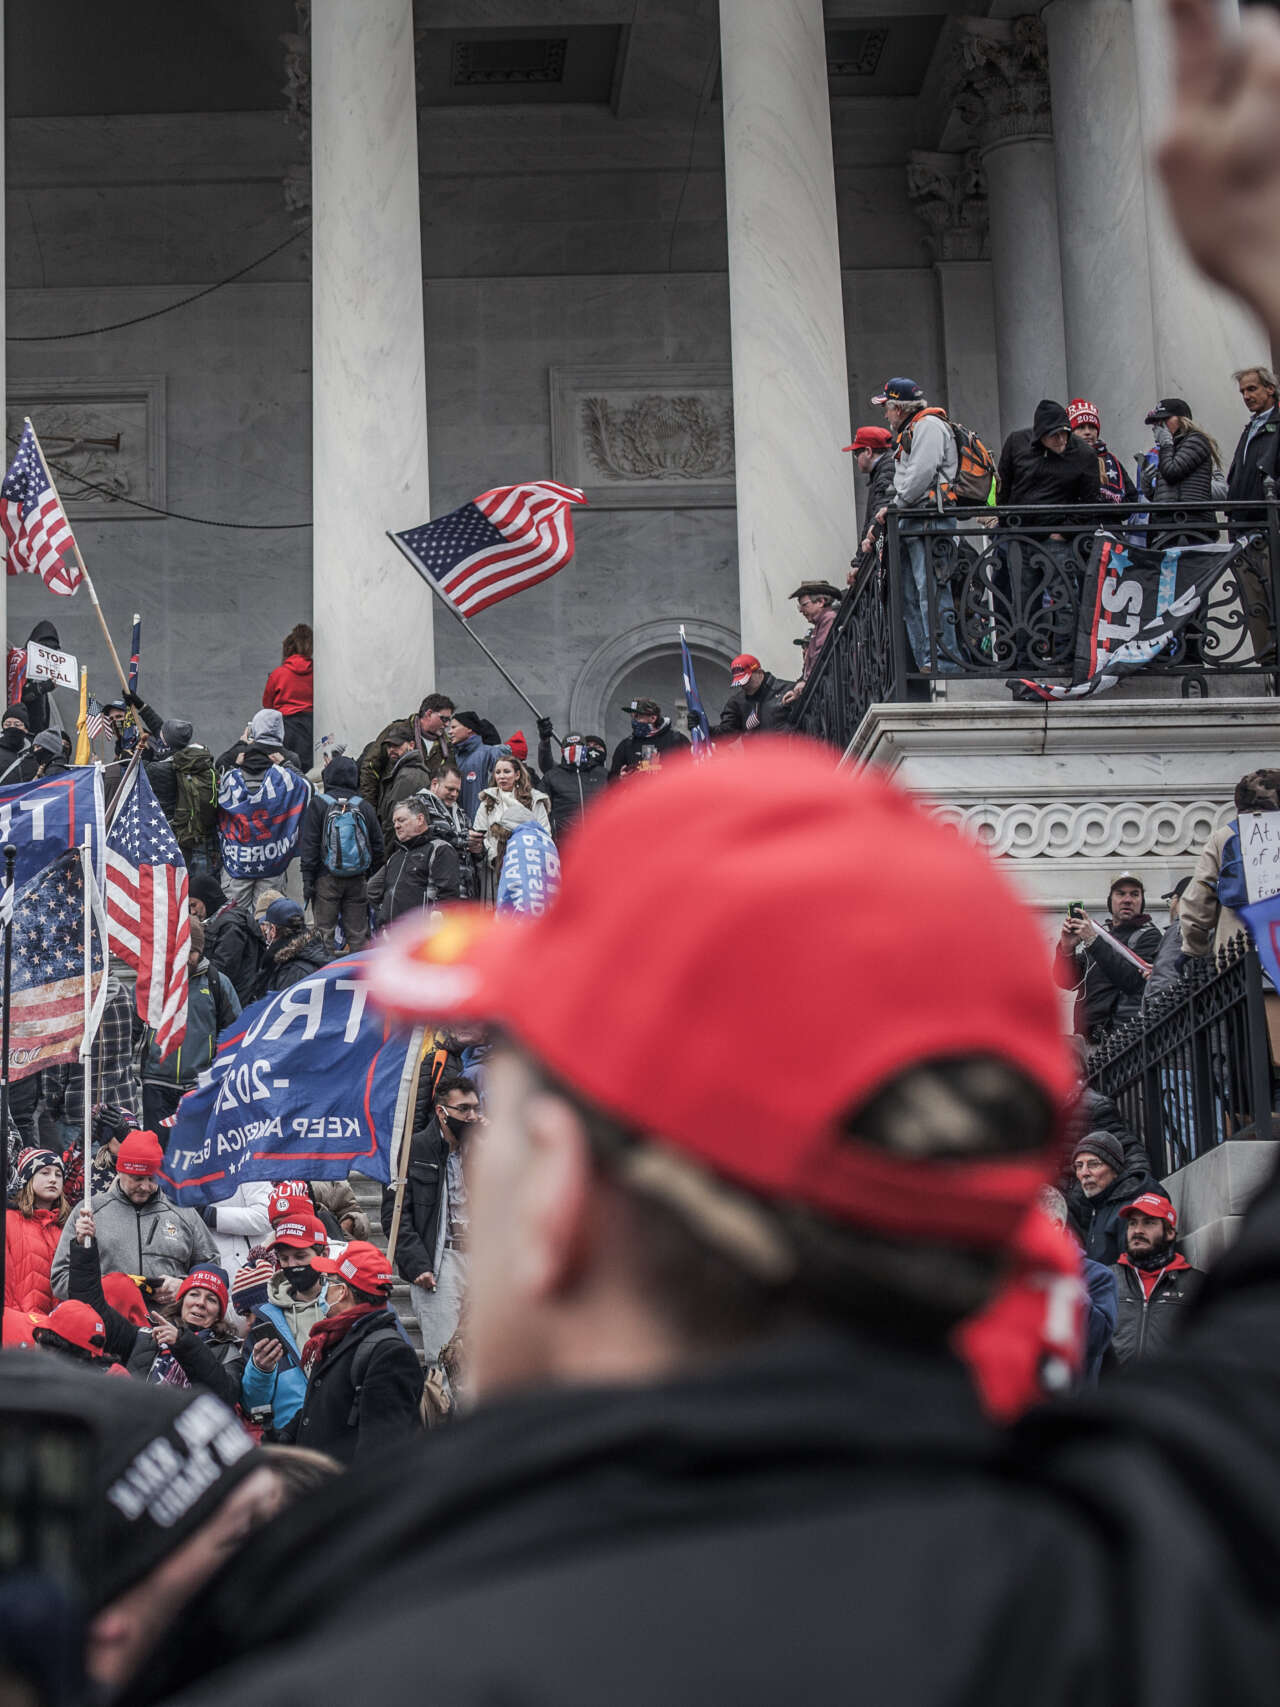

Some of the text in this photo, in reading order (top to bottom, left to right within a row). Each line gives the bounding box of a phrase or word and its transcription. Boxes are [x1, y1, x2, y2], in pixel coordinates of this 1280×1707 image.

[38, 648, 66, 665] STOP
[35, 664, 72, 683] STEAL
[1249, 823, 1272, 846] At
[1252, 848, 1269, 866] of
[193, 1272, 222, 1285] TRUMP
